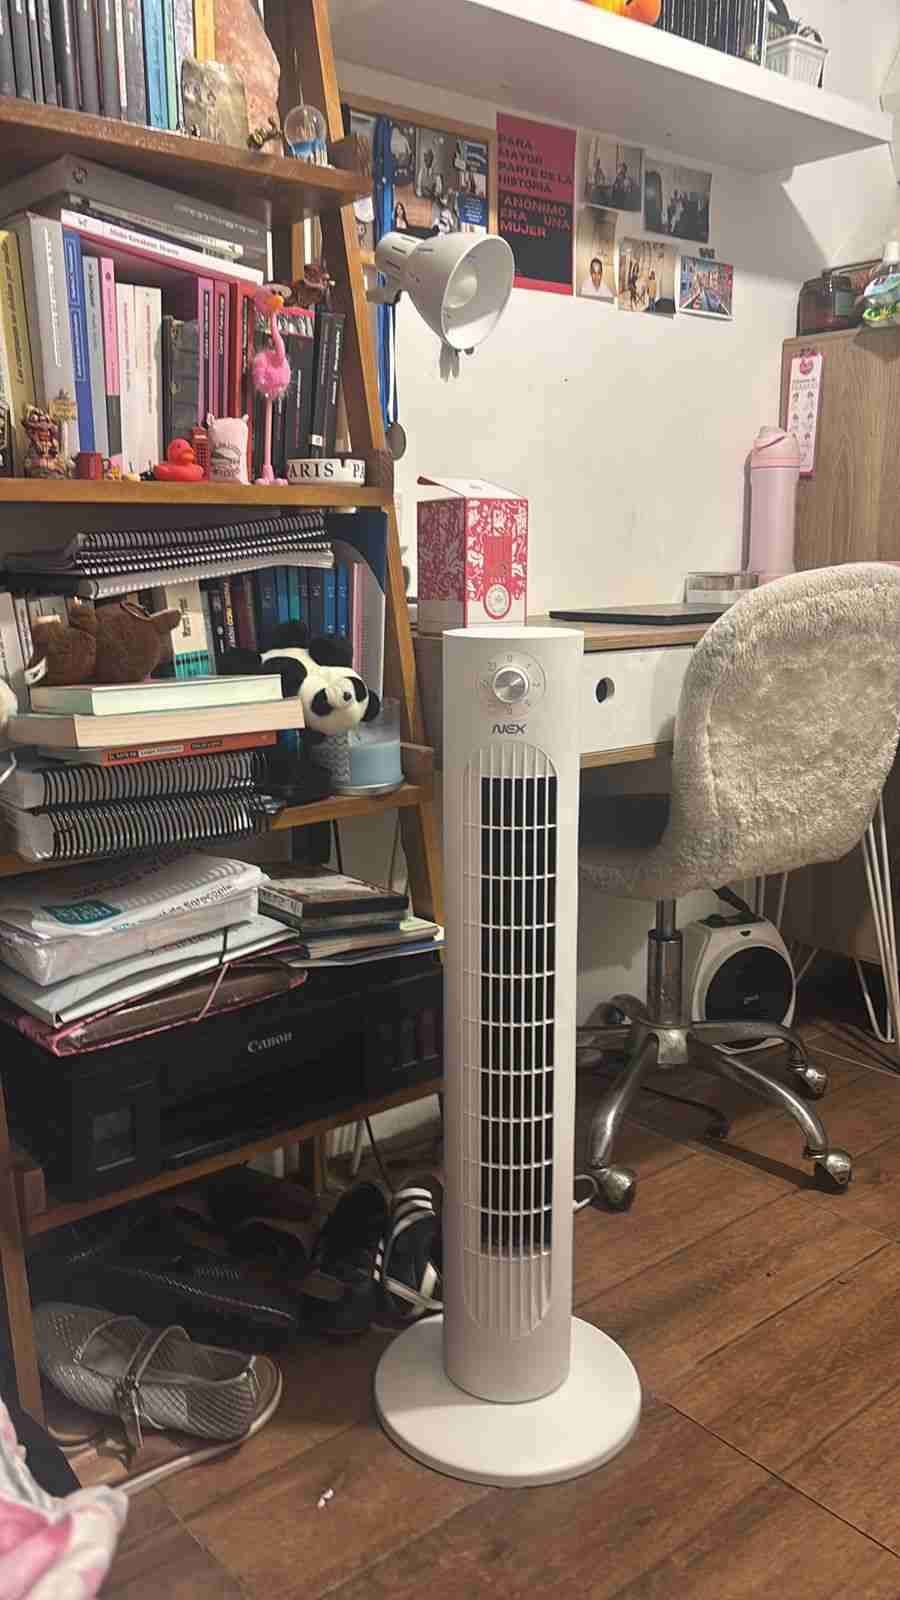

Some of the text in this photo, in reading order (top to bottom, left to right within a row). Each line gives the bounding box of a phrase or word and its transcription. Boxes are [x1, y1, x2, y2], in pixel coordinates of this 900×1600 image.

[498, 134, 534, 150] PARA
[498, 147, 543, 166] MAYOR
[498, 161, 539, 179] PARTE
[499, 221, 548, 238] MUJER
[289, 462, 335, 478] ARIS
[492, 723, 527, 735] NEX
[247, 1031, 292, 1053] Canon
